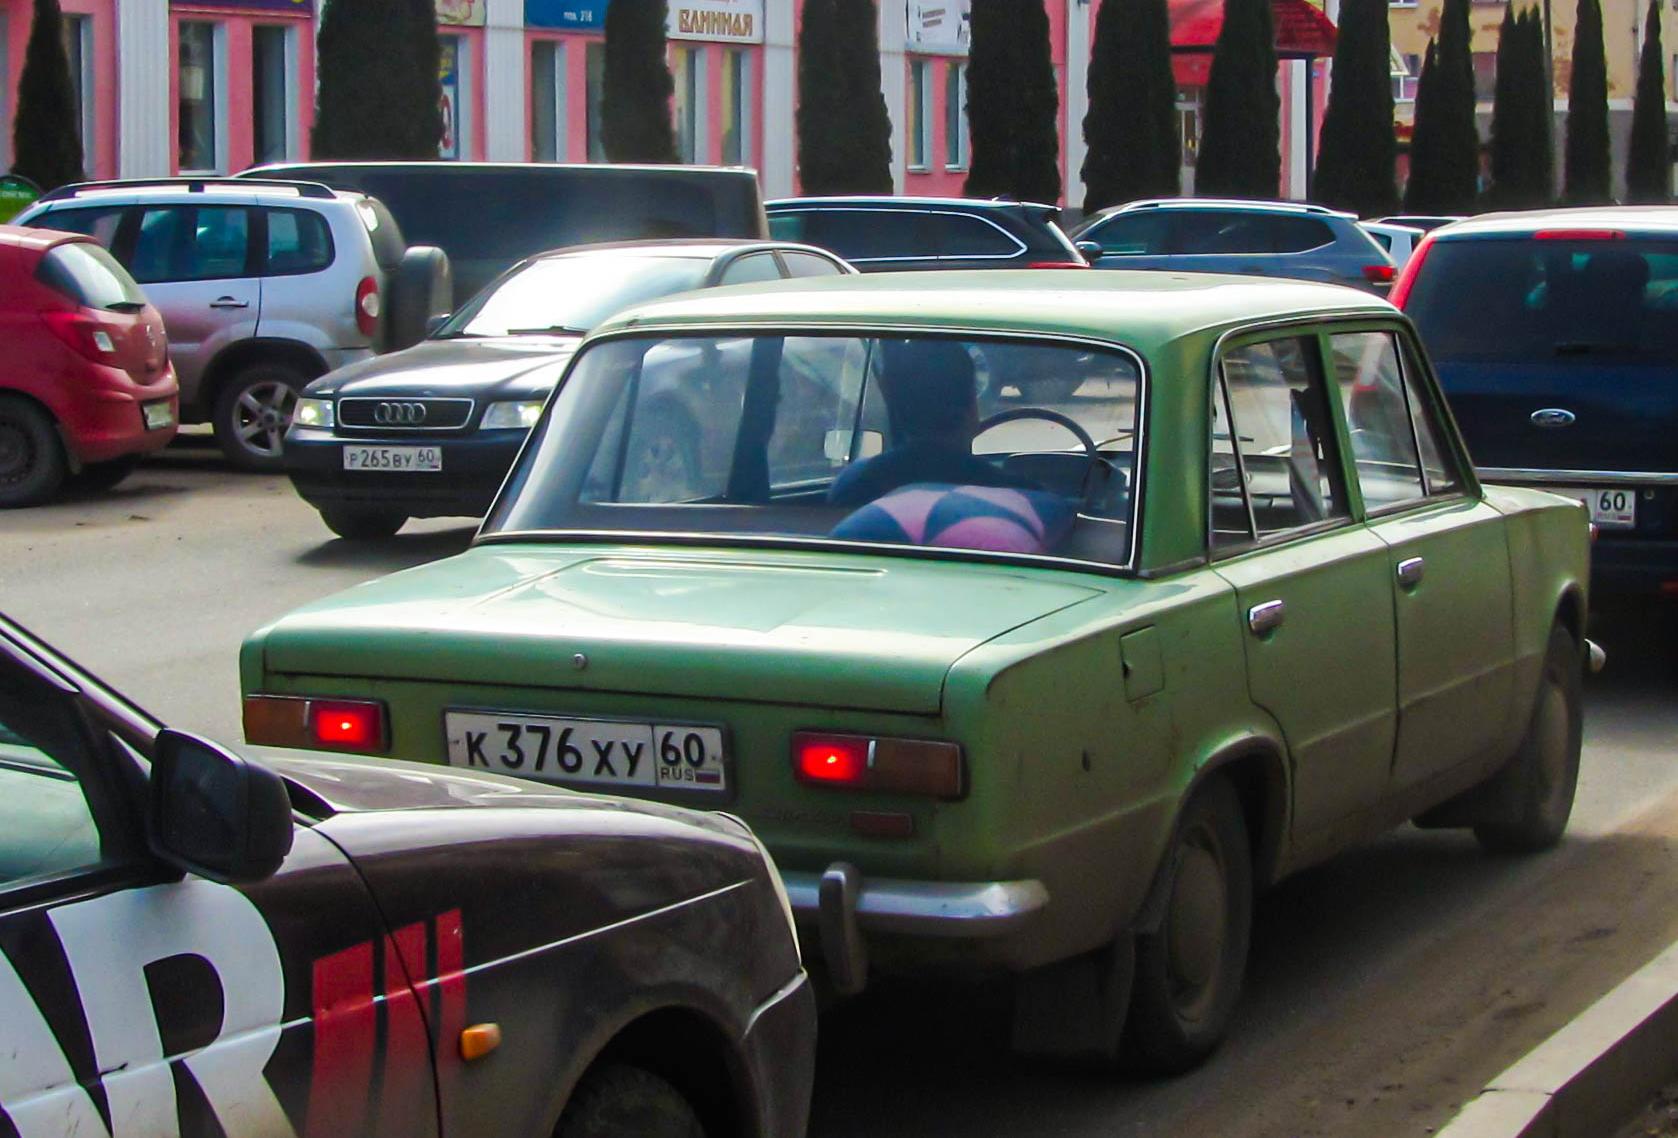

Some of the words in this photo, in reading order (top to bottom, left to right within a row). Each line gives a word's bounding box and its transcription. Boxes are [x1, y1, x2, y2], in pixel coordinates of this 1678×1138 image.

[1600, 491, 1626, 511] 60
[465, 723, 645, 778] К376ХУ
[660, 731, 706, 768] 60
[660, 768, 695, 781] RUS
